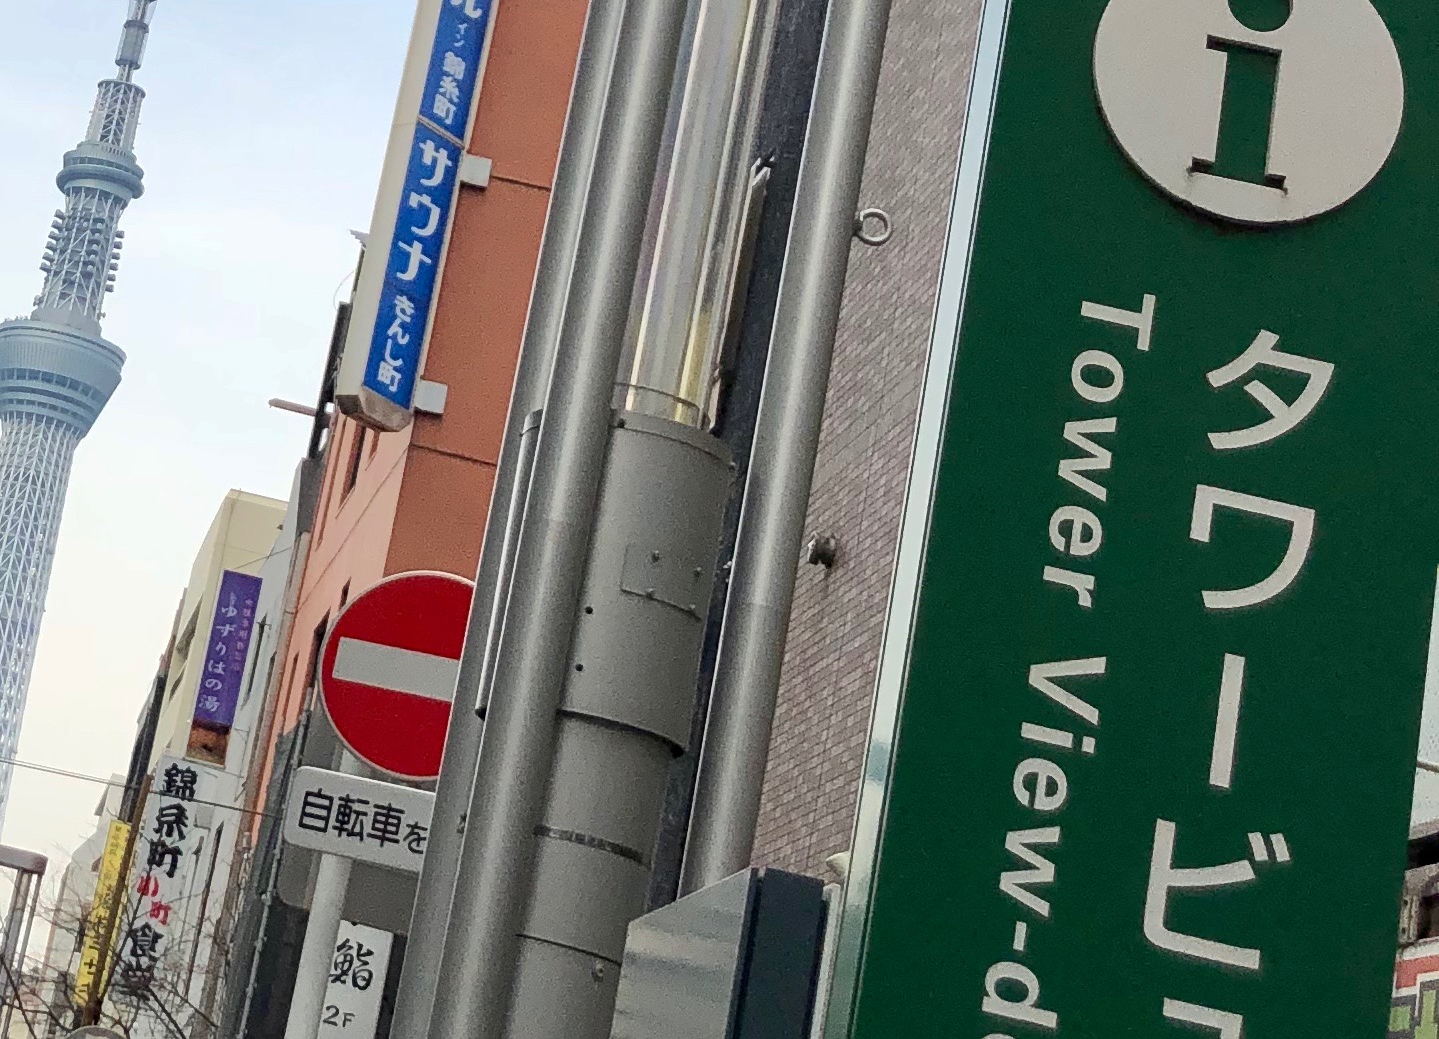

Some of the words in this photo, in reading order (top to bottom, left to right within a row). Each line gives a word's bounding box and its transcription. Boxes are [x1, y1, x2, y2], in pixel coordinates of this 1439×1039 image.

[1043, 293, 1156, 609] Tower
[298, 787, 429, 855] 自転車を
[980, 655, 1108, 1039] View-d
[329, 937, 375, 992] 鮨
[322, 1004, 356, 1029] 2F
